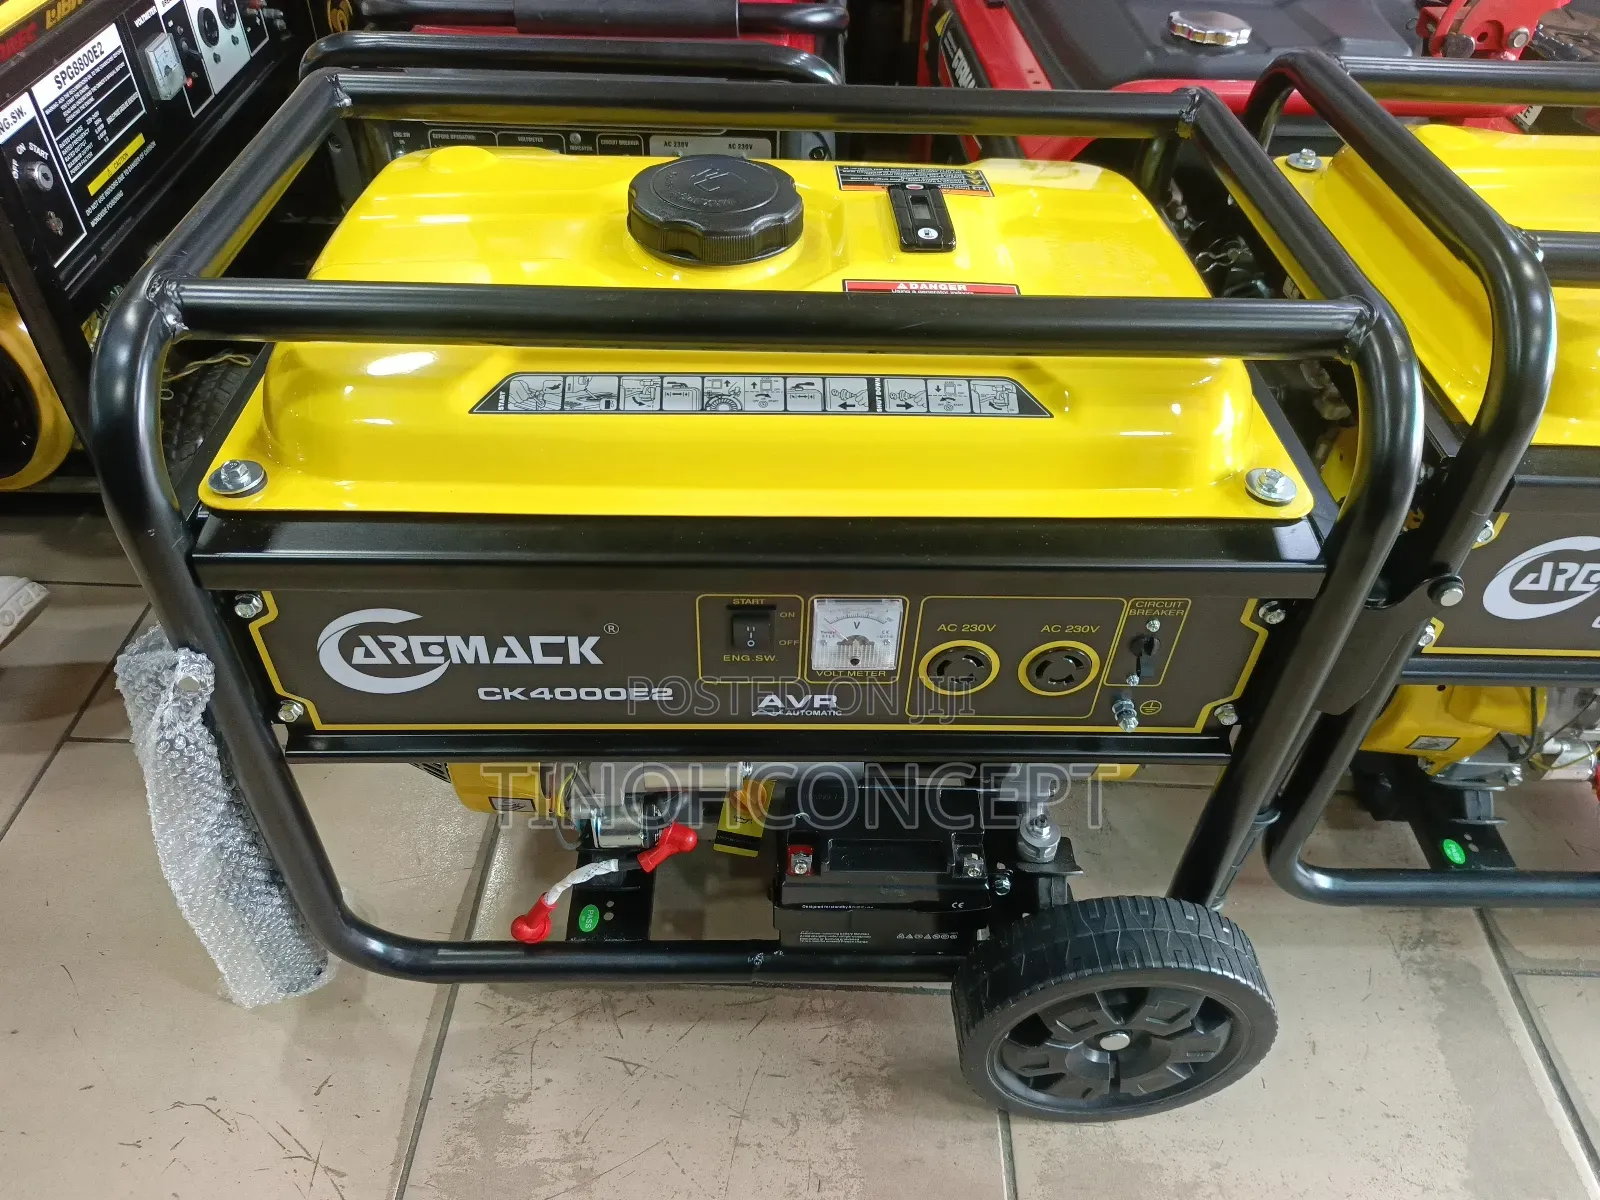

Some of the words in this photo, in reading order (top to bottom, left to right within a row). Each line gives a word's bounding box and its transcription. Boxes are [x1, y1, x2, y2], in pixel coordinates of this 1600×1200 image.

[54, 41, 105, 90] SPG8800E2
[16, 142, 26, 155] ON
[28, 141, 49, 160] START
[12, 158, 20, 179] OFF
[1135, 600, 1183, 608] CIRCUIT
[1129, 608, 1185, 617] BREAKER
[853, 621, 861, 629] V
[937, 623, 959, 632] AC
[961, 623, 996, 632] 230V
[1040, 625, 1063, 634] AC
[1065, 625, 1100, 634] 230V
[723, 654, 778, 662] ENG.SW.
[477, 686, 674, 701] CK4000E2
[758, 694, 838, 708] AVR
[585, 909, 594, 929] PASS
